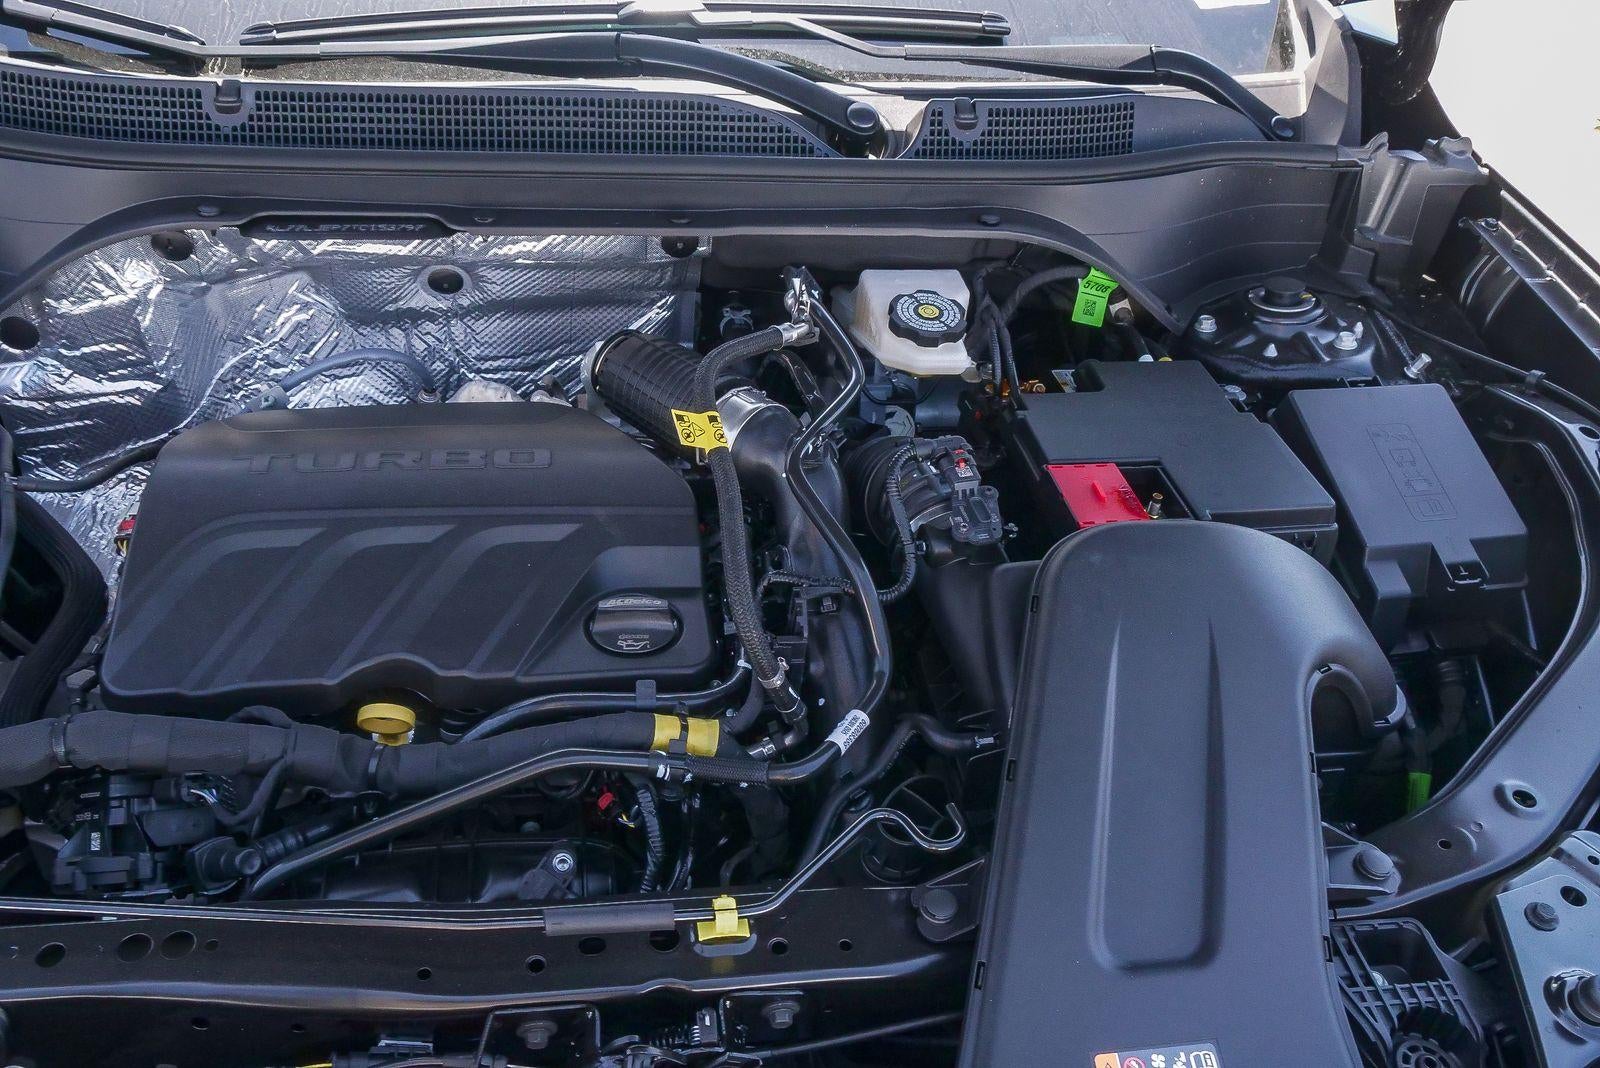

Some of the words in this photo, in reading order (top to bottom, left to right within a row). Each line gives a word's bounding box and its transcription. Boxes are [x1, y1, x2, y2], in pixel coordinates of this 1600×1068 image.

[1083, 280, 1111, 293] 5708
[231, 450, 552, 475] TURBO
[607, 598, 662, 606] ACDelco
